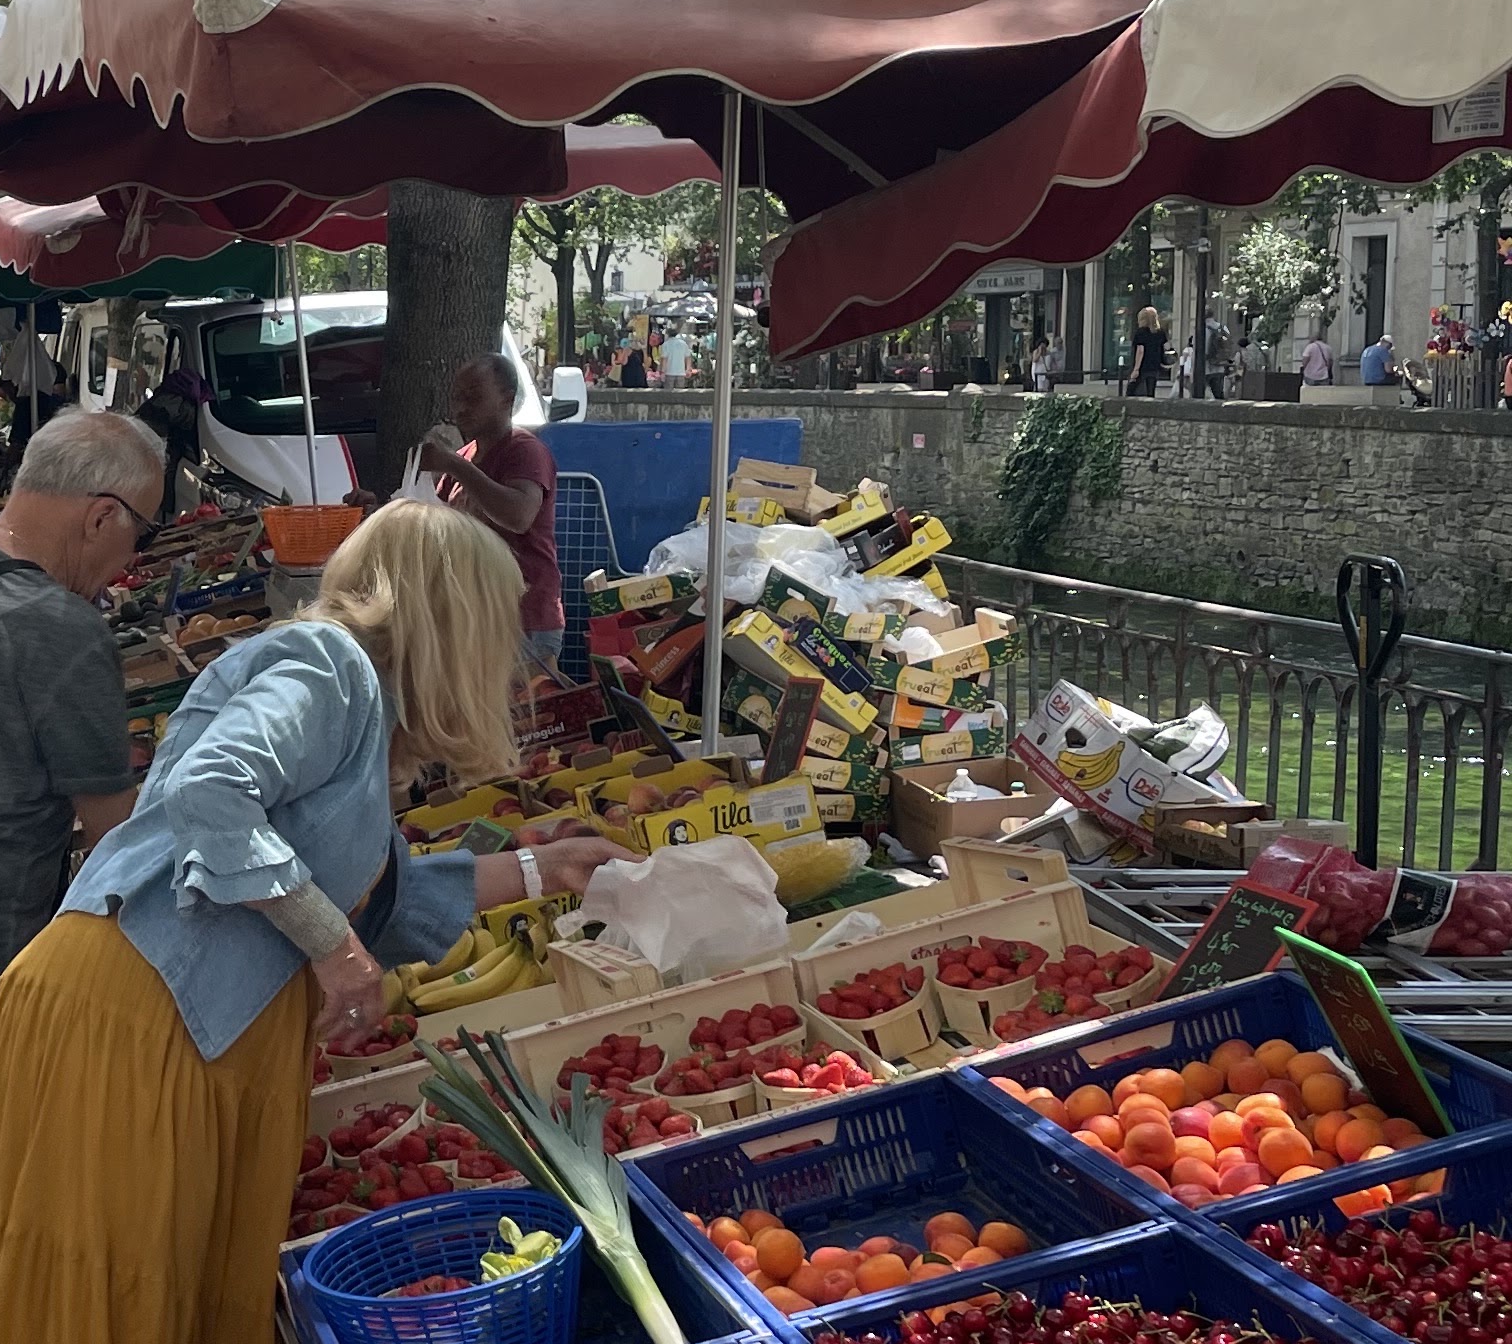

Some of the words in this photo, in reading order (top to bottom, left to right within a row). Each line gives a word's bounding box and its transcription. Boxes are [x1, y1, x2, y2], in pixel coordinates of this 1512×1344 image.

[650, 646, 681, 677] Princess
[1133, 777, 1161, 799] Dole
[709, 801, 753, 836] Lila
